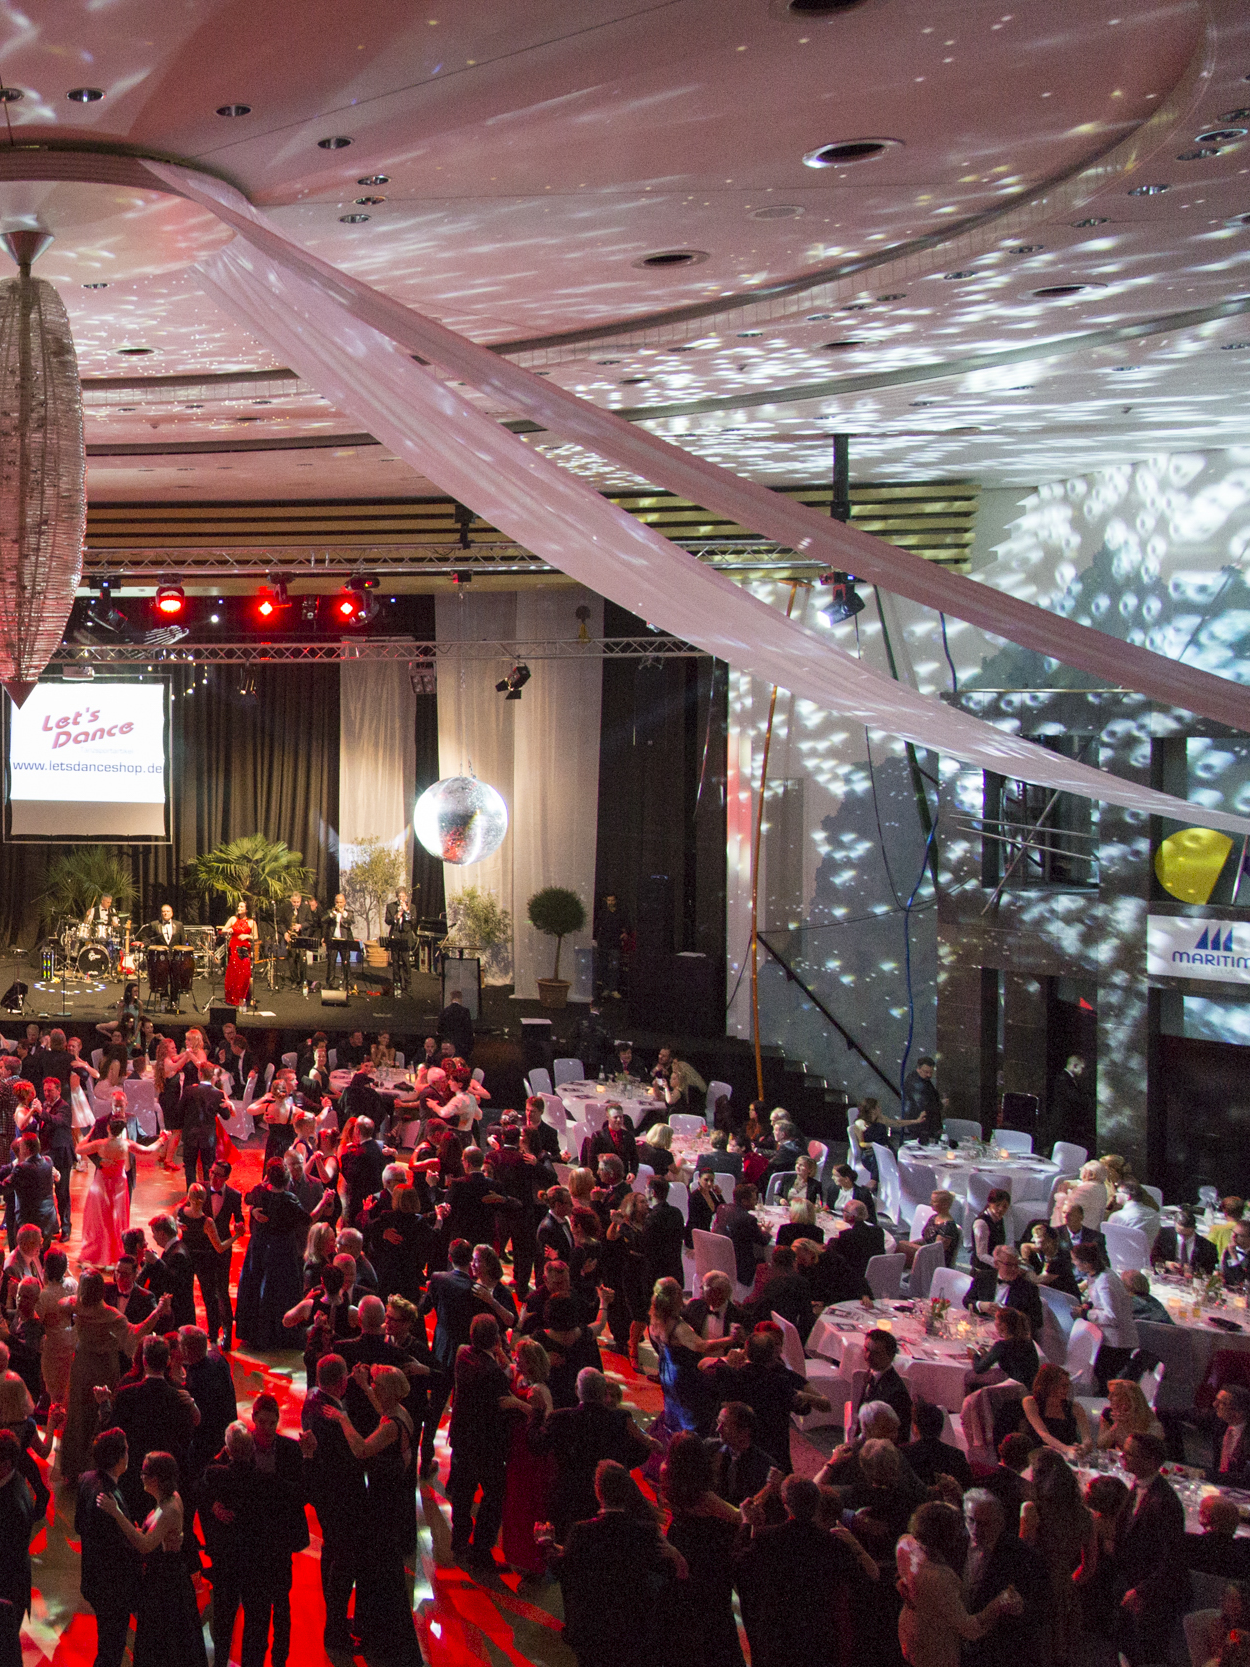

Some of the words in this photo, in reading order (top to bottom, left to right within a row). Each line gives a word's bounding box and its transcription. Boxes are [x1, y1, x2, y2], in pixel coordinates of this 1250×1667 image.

[42, 707, 101, 732] Let's
[51, 721, 135, 749] Dance
[12, 760, 163, 776] www.letsdanceshop.de
